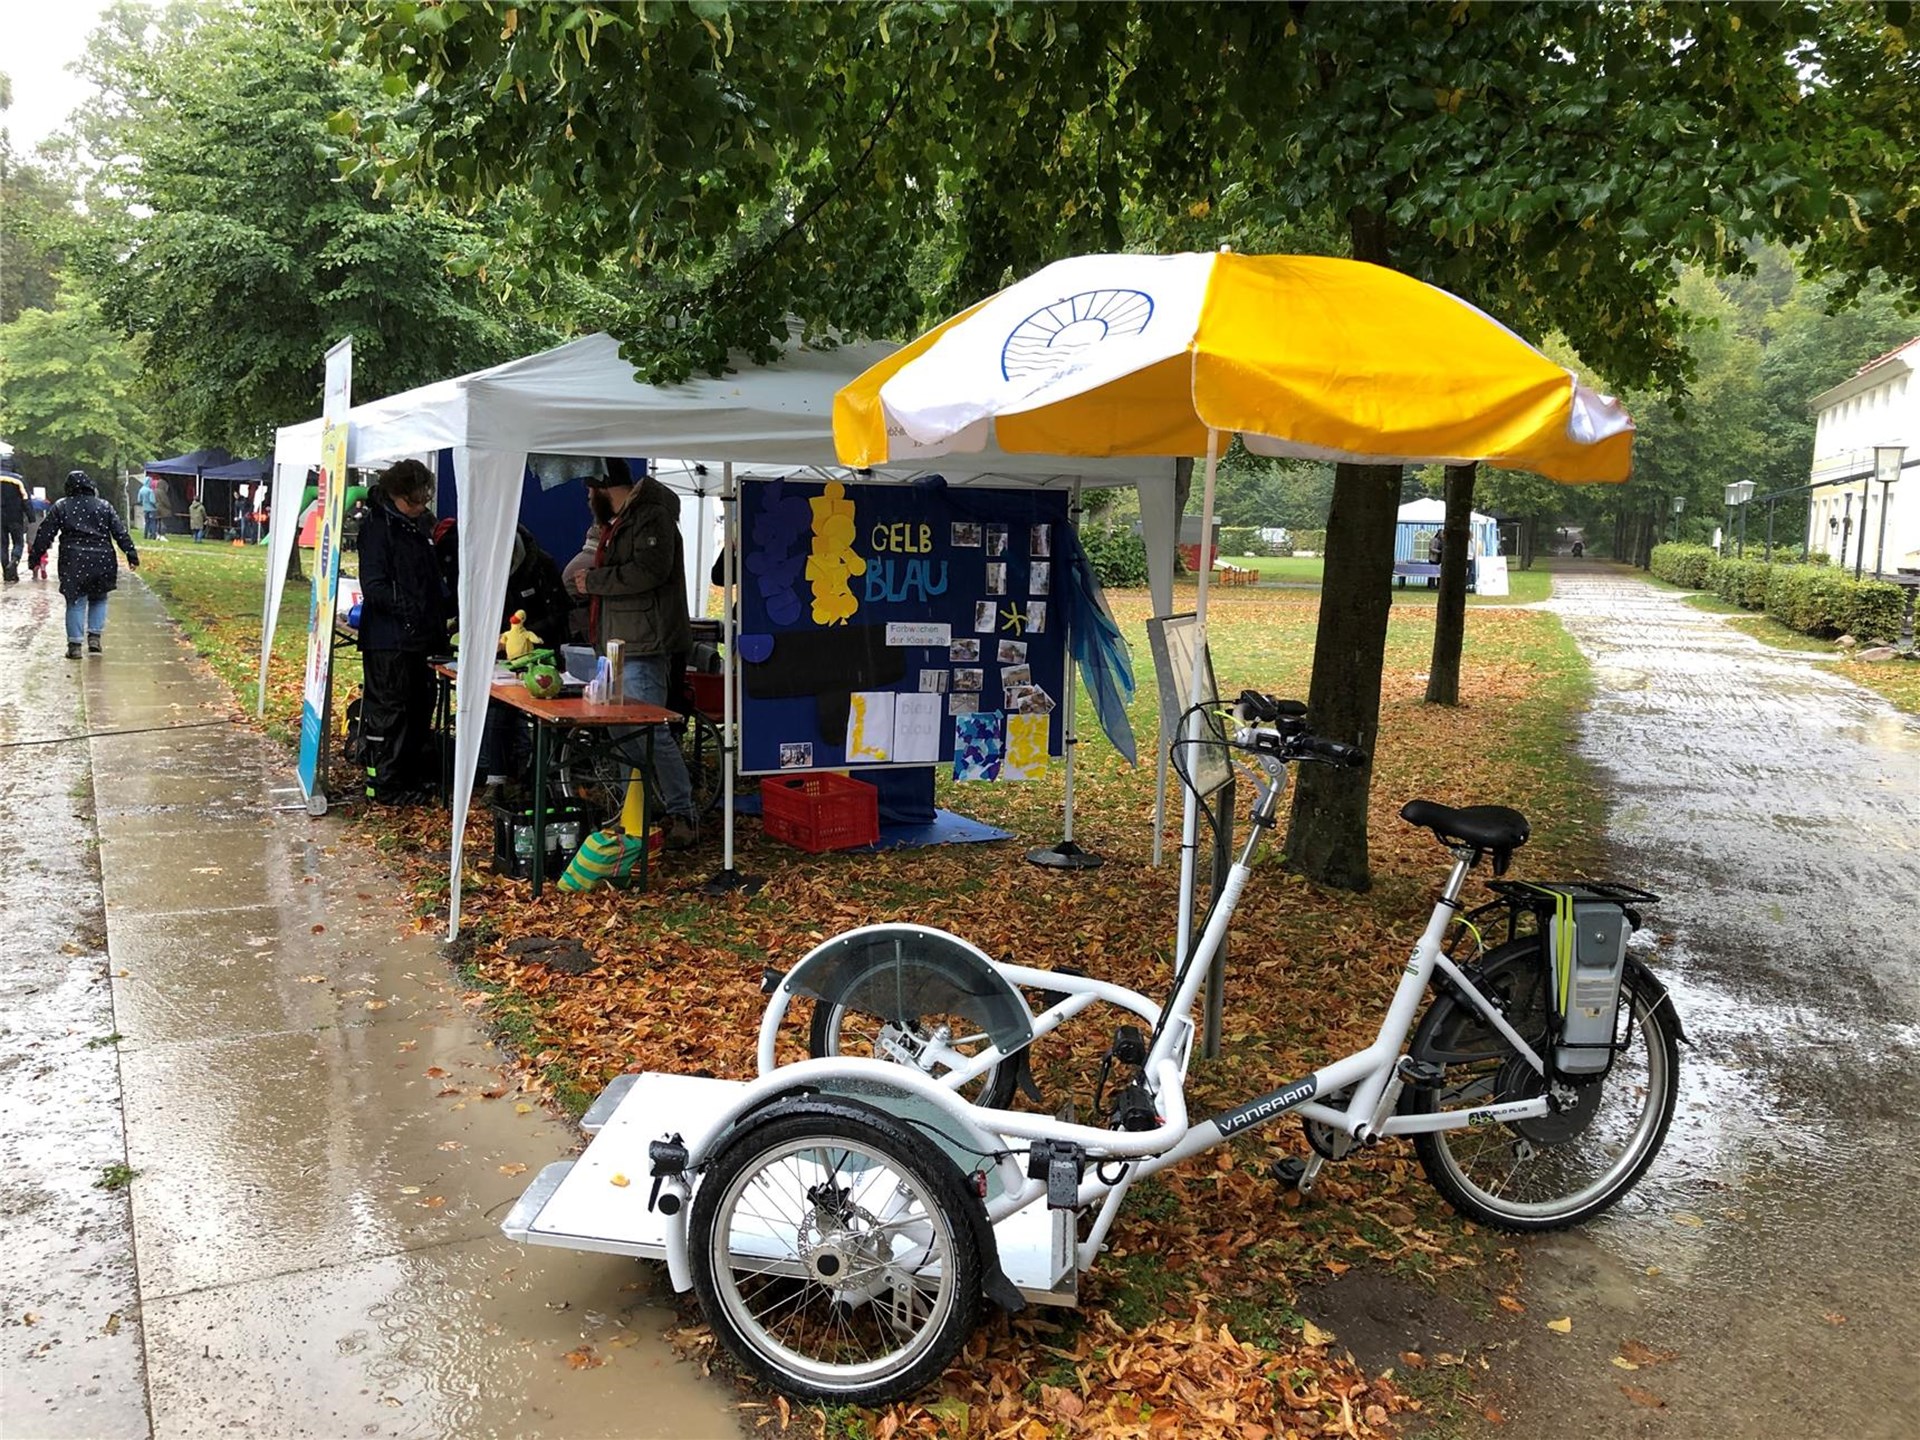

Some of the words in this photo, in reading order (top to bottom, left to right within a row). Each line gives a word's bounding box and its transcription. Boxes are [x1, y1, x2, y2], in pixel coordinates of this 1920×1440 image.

[871, 522, 932, 553] GELB
[864, 560, 948, 602] BLAU
[890, 624, 939, 633] Farbwchen
[890, 636, 904, 644] dr
[907, 636, 934, 644] Klae
